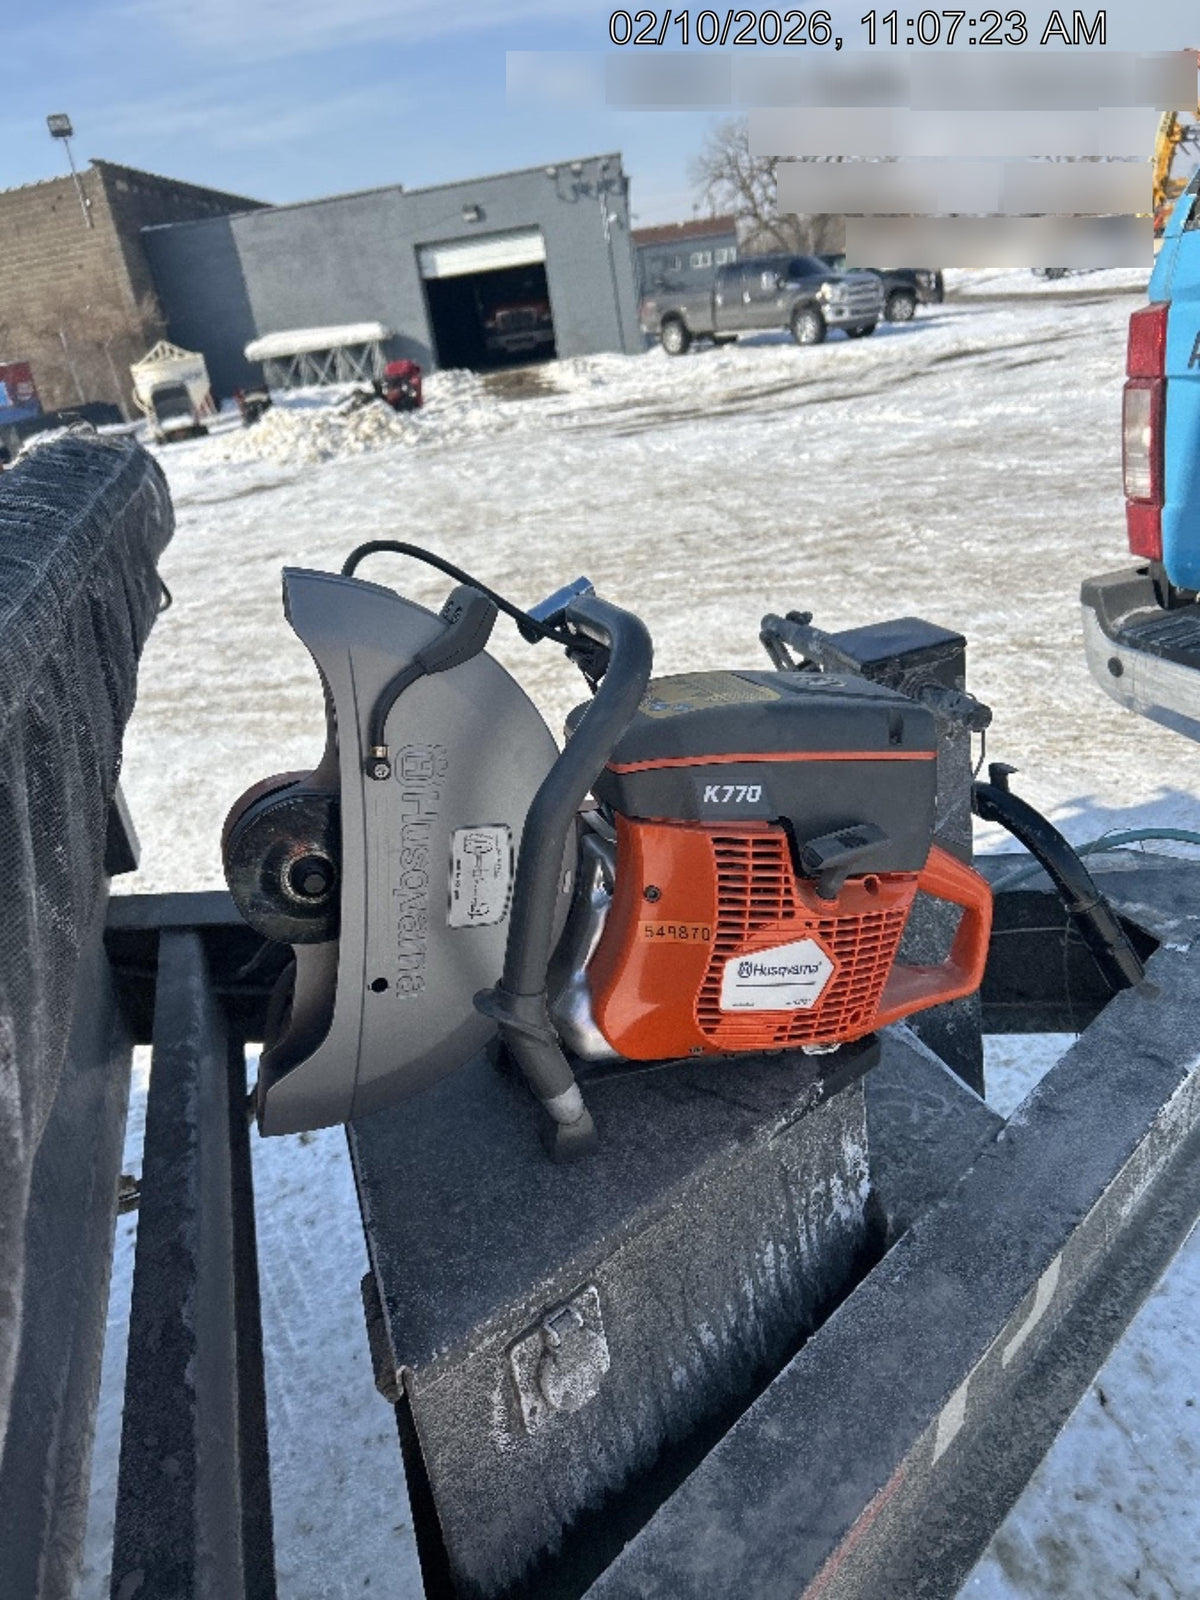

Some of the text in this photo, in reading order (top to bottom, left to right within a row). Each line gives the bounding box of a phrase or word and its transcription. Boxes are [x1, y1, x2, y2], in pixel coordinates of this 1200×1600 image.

[703, 785, 762, 803] K770
[393, 791, 440, 999] Husqvarna
[645, 925, 711, 942] 549870
[753, 962, 820, 978] Husqvarna
